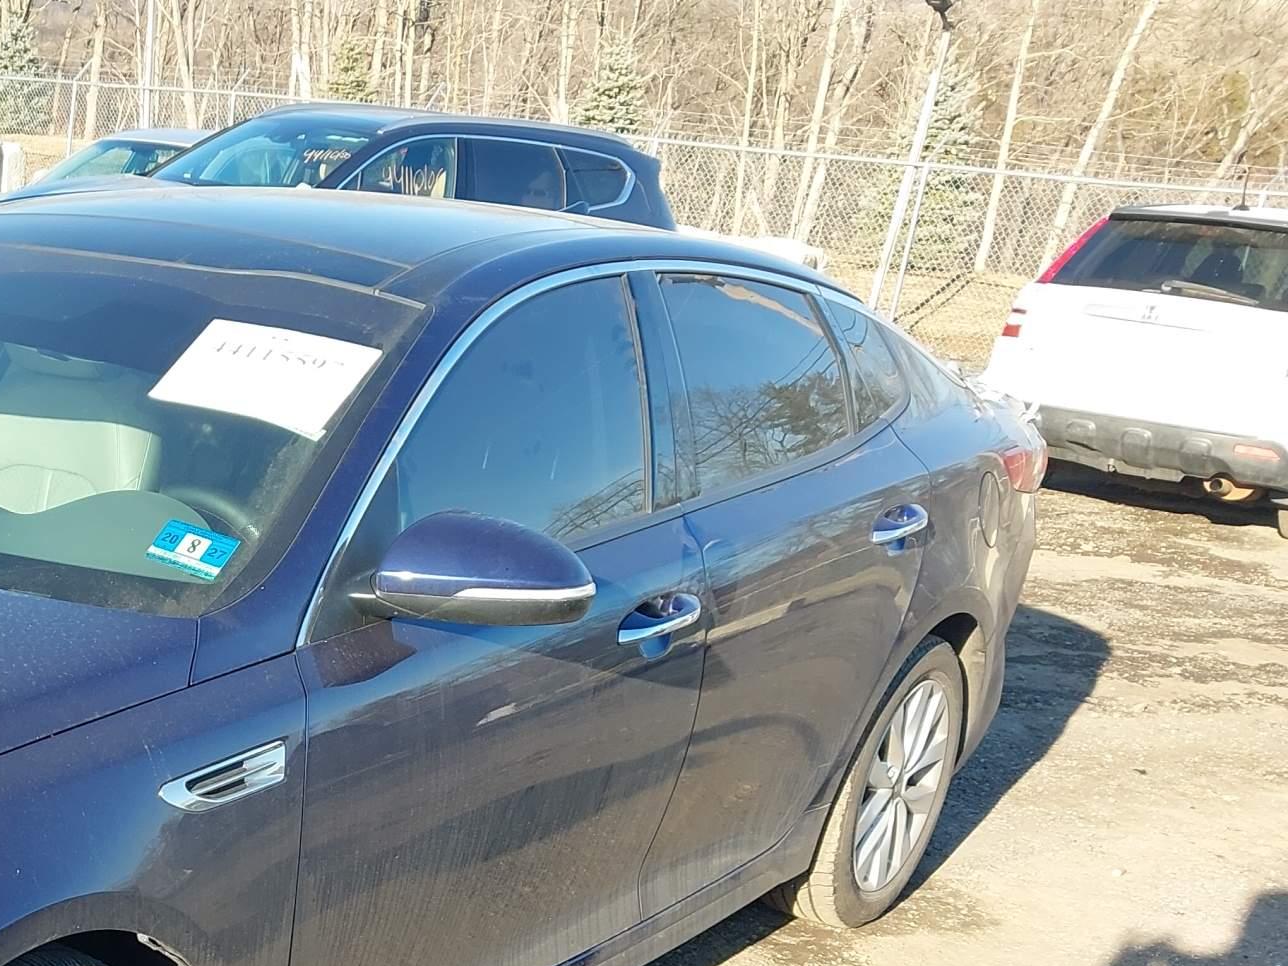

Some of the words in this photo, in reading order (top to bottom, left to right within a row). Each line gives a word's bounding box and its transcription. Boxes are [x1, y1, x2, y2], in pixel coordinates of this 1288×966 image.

[161, 532, 180, 545] 20
[186, 538, 202, 554] 8
[207, 548, 228, 560] 27
